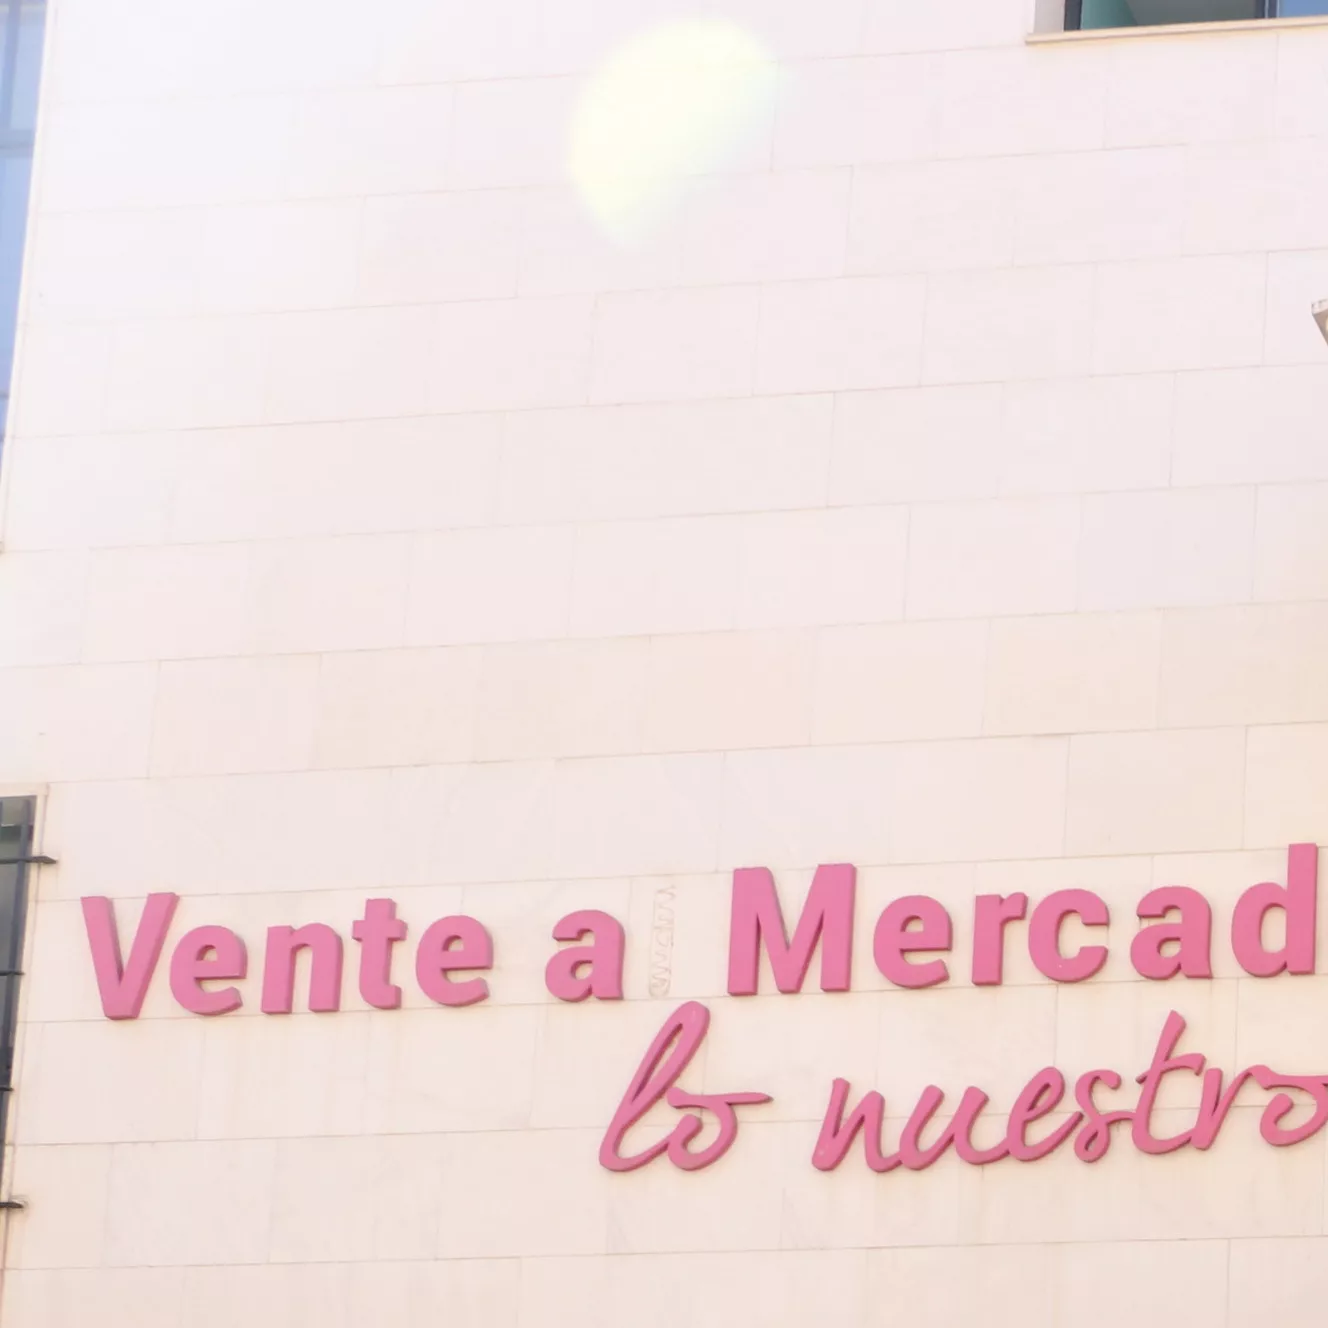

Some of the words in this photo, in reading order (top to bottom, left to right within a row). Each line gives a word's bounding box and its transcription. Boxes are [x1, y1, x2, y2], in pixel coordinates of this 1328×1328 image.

[83, 894, 492, 1021] Vente
[546, 911, 625, 1002] a
[600, 1001, 770, 1173] lo
